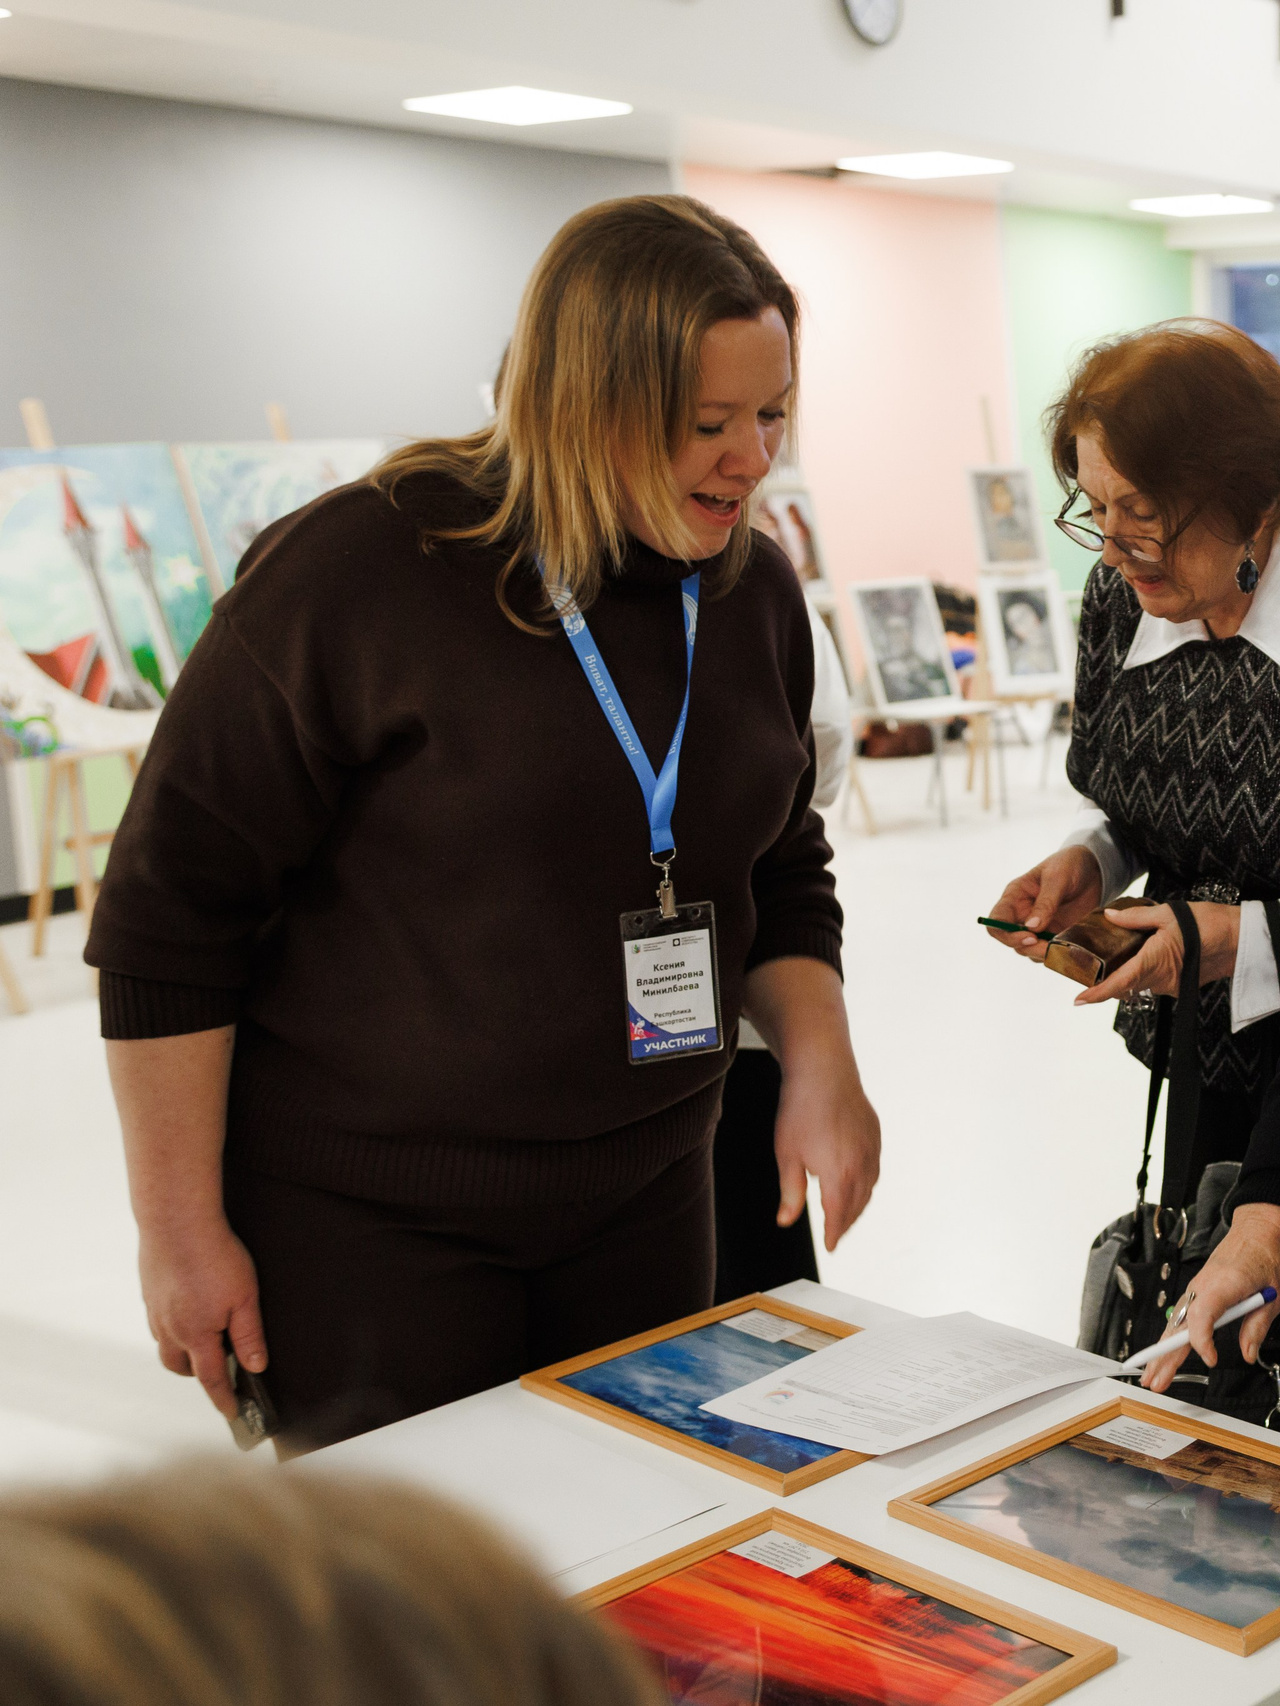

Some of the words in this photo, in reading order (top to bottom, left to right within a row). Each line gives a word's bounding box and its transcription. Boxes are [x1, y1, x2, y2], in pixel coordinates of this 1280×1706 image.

[585, 654, 609, 697] Виват,
[606, 697, 640, 756] таланты!
[653, 960, 685, 972] Ксения
[636, 970, 704, 987] Владимировна
[642, 981, 699, 998] Минилбаева
[654, 1008, 692, 1018] Республика
[644, 1033, 706, 1053] УЧАСТНИК
